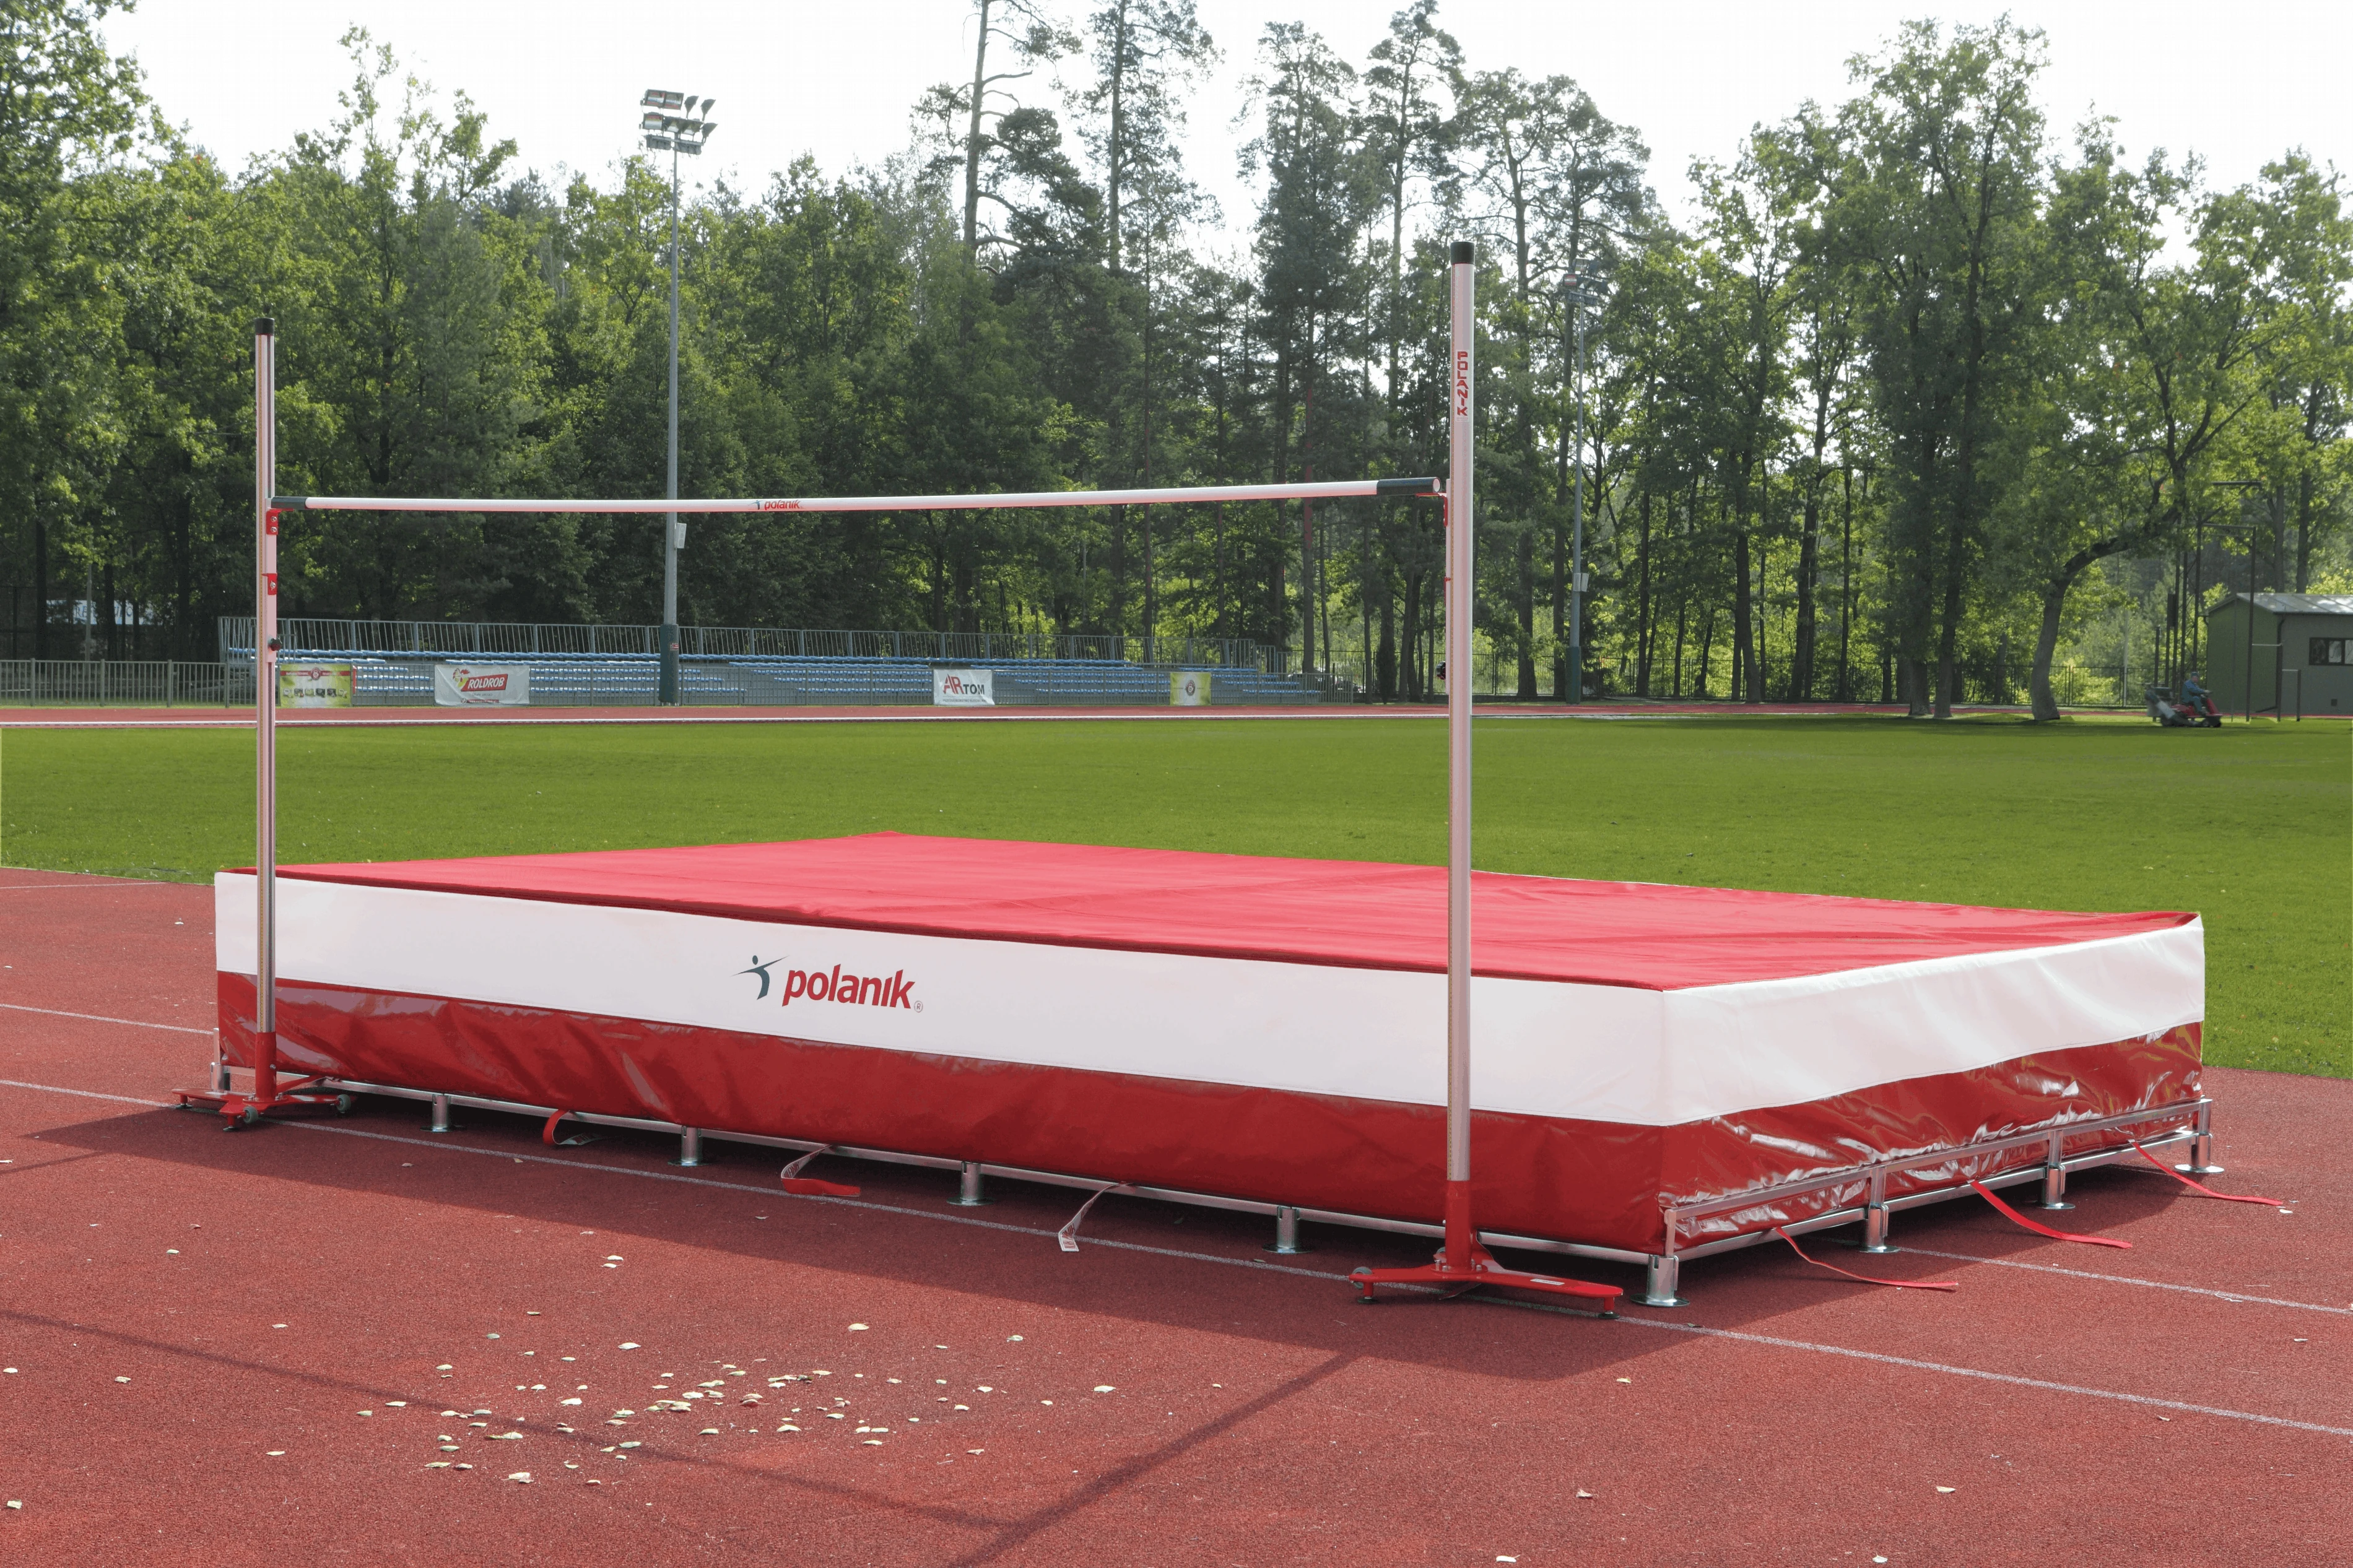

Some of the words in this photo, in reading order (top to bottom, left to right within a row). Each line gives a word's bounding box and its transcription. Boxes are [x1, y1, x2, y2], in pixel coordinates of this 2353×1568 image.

[1456, 351, 1469, 417] POLANIK
[764, 500, 801, 511] polanik
[468, 677, 505, 689] ROLDROB
[781, 963, 916, 1009] polanik
